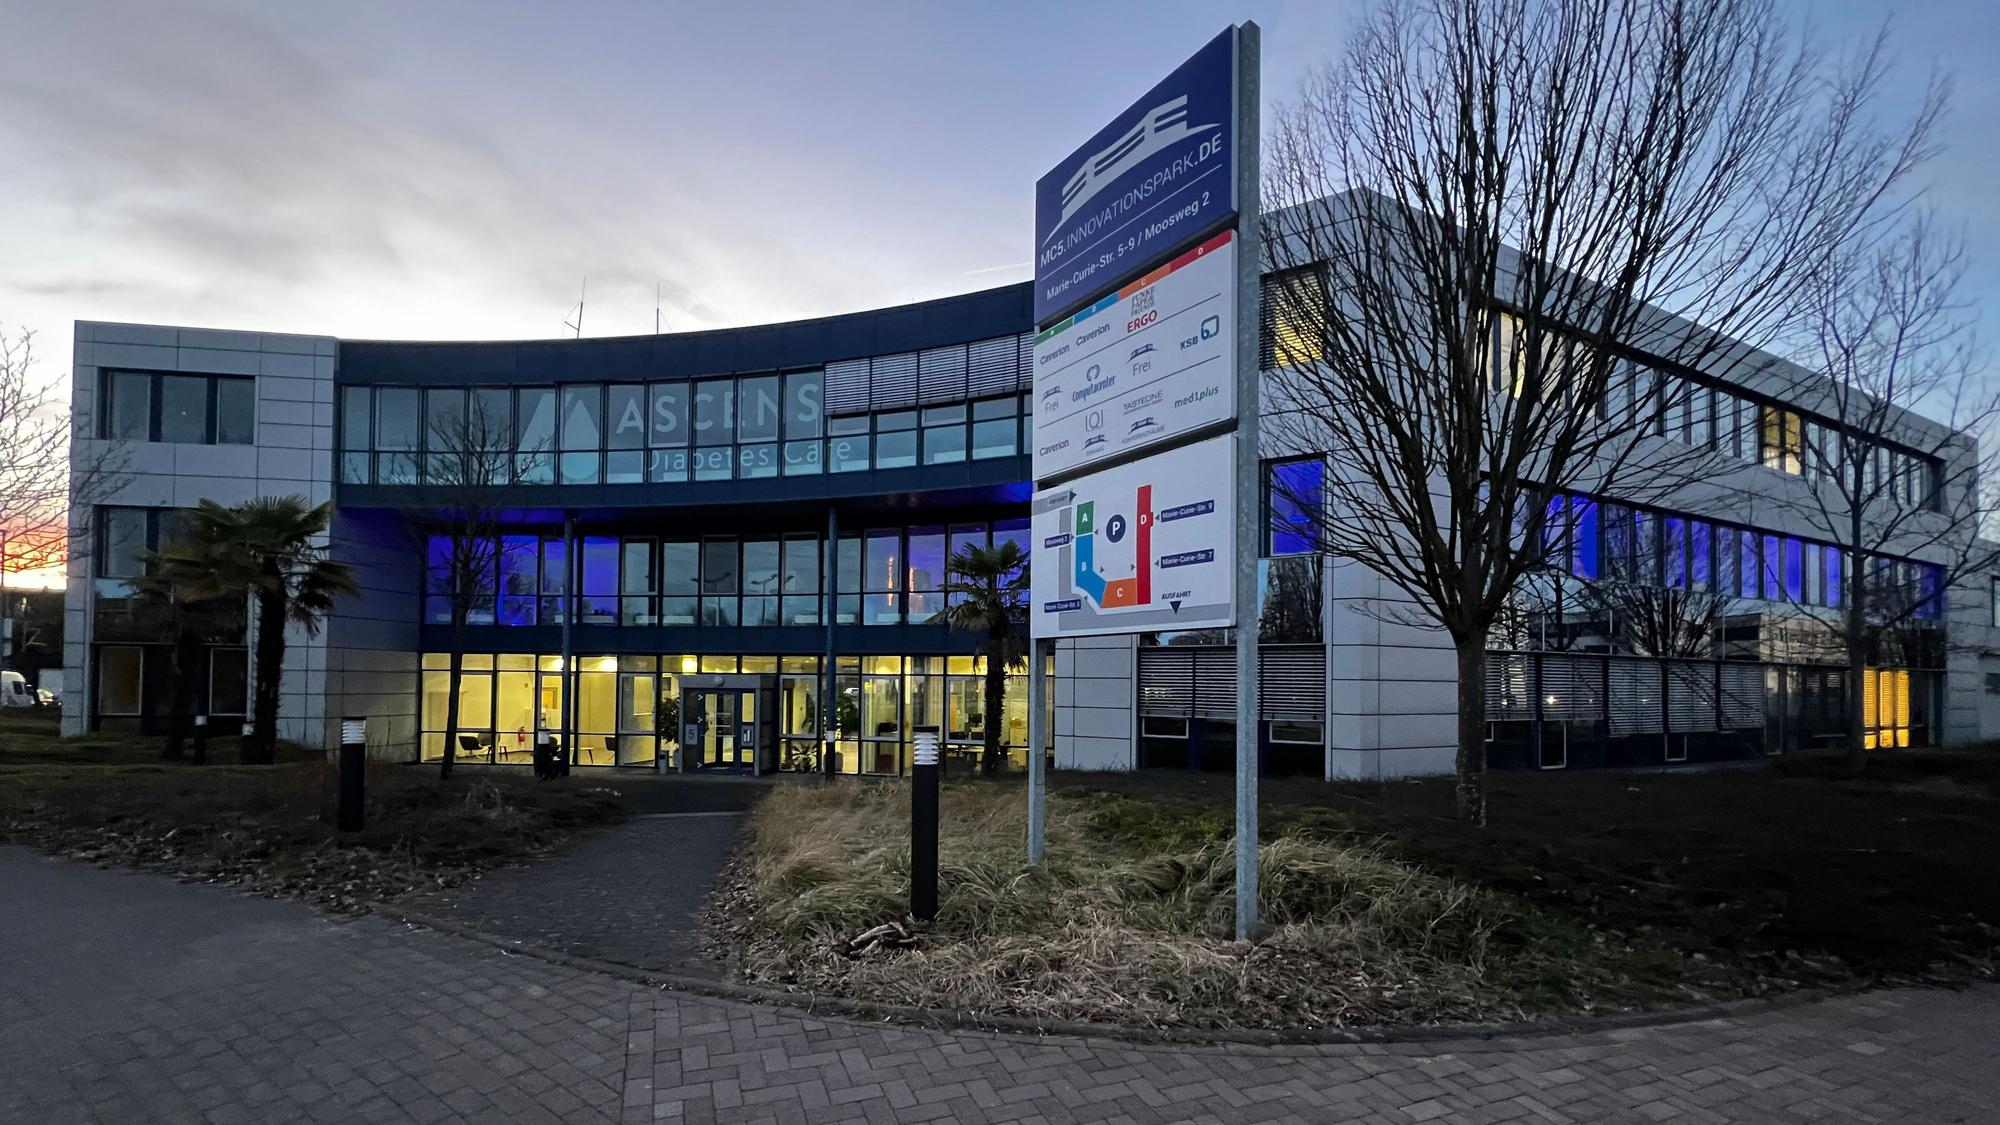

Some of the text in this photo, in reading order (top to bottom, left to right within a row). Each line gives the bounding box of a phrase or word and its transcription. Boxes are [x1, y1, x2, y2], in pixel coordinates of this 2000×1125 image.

[1040, 132, 1222, 268] MC5.INNOVATIONSPARK.DE
[1047, 253, 1115, 300] Marie-Curie-Str.
[1117, 240, 1135, 258] 5-9
[1144, 201, 1199, 240] Moosweg
[1201, 191, 1210, 206] 2
[1127, 310, 1157, 333] ERGO
[1076, 322, 1110, 346] Caverion
[1180, 335, 1199, 351] KSB
[1040, 343, 1070, 365] Caverion
[1132, 358, 1151, 376] Frei
[1072, 374, 1116, 403] Computacenter
[1174, 384, 1219, 409] med1plus
[1044, 399, 1059, 414] Frei
[1039, 439, 1070, 457] Caverion
[1081, 512, 1088, 524] A
[1140, 514, 1147, 525] D
[1112, 521, 1120, 535] P
[1081, 561, 1088, 572] B
[1116, 587, 1123, 597] C
[1161, 590, 1192, 600] AUSFAHRT
[688, 729, 695, 740] 5
